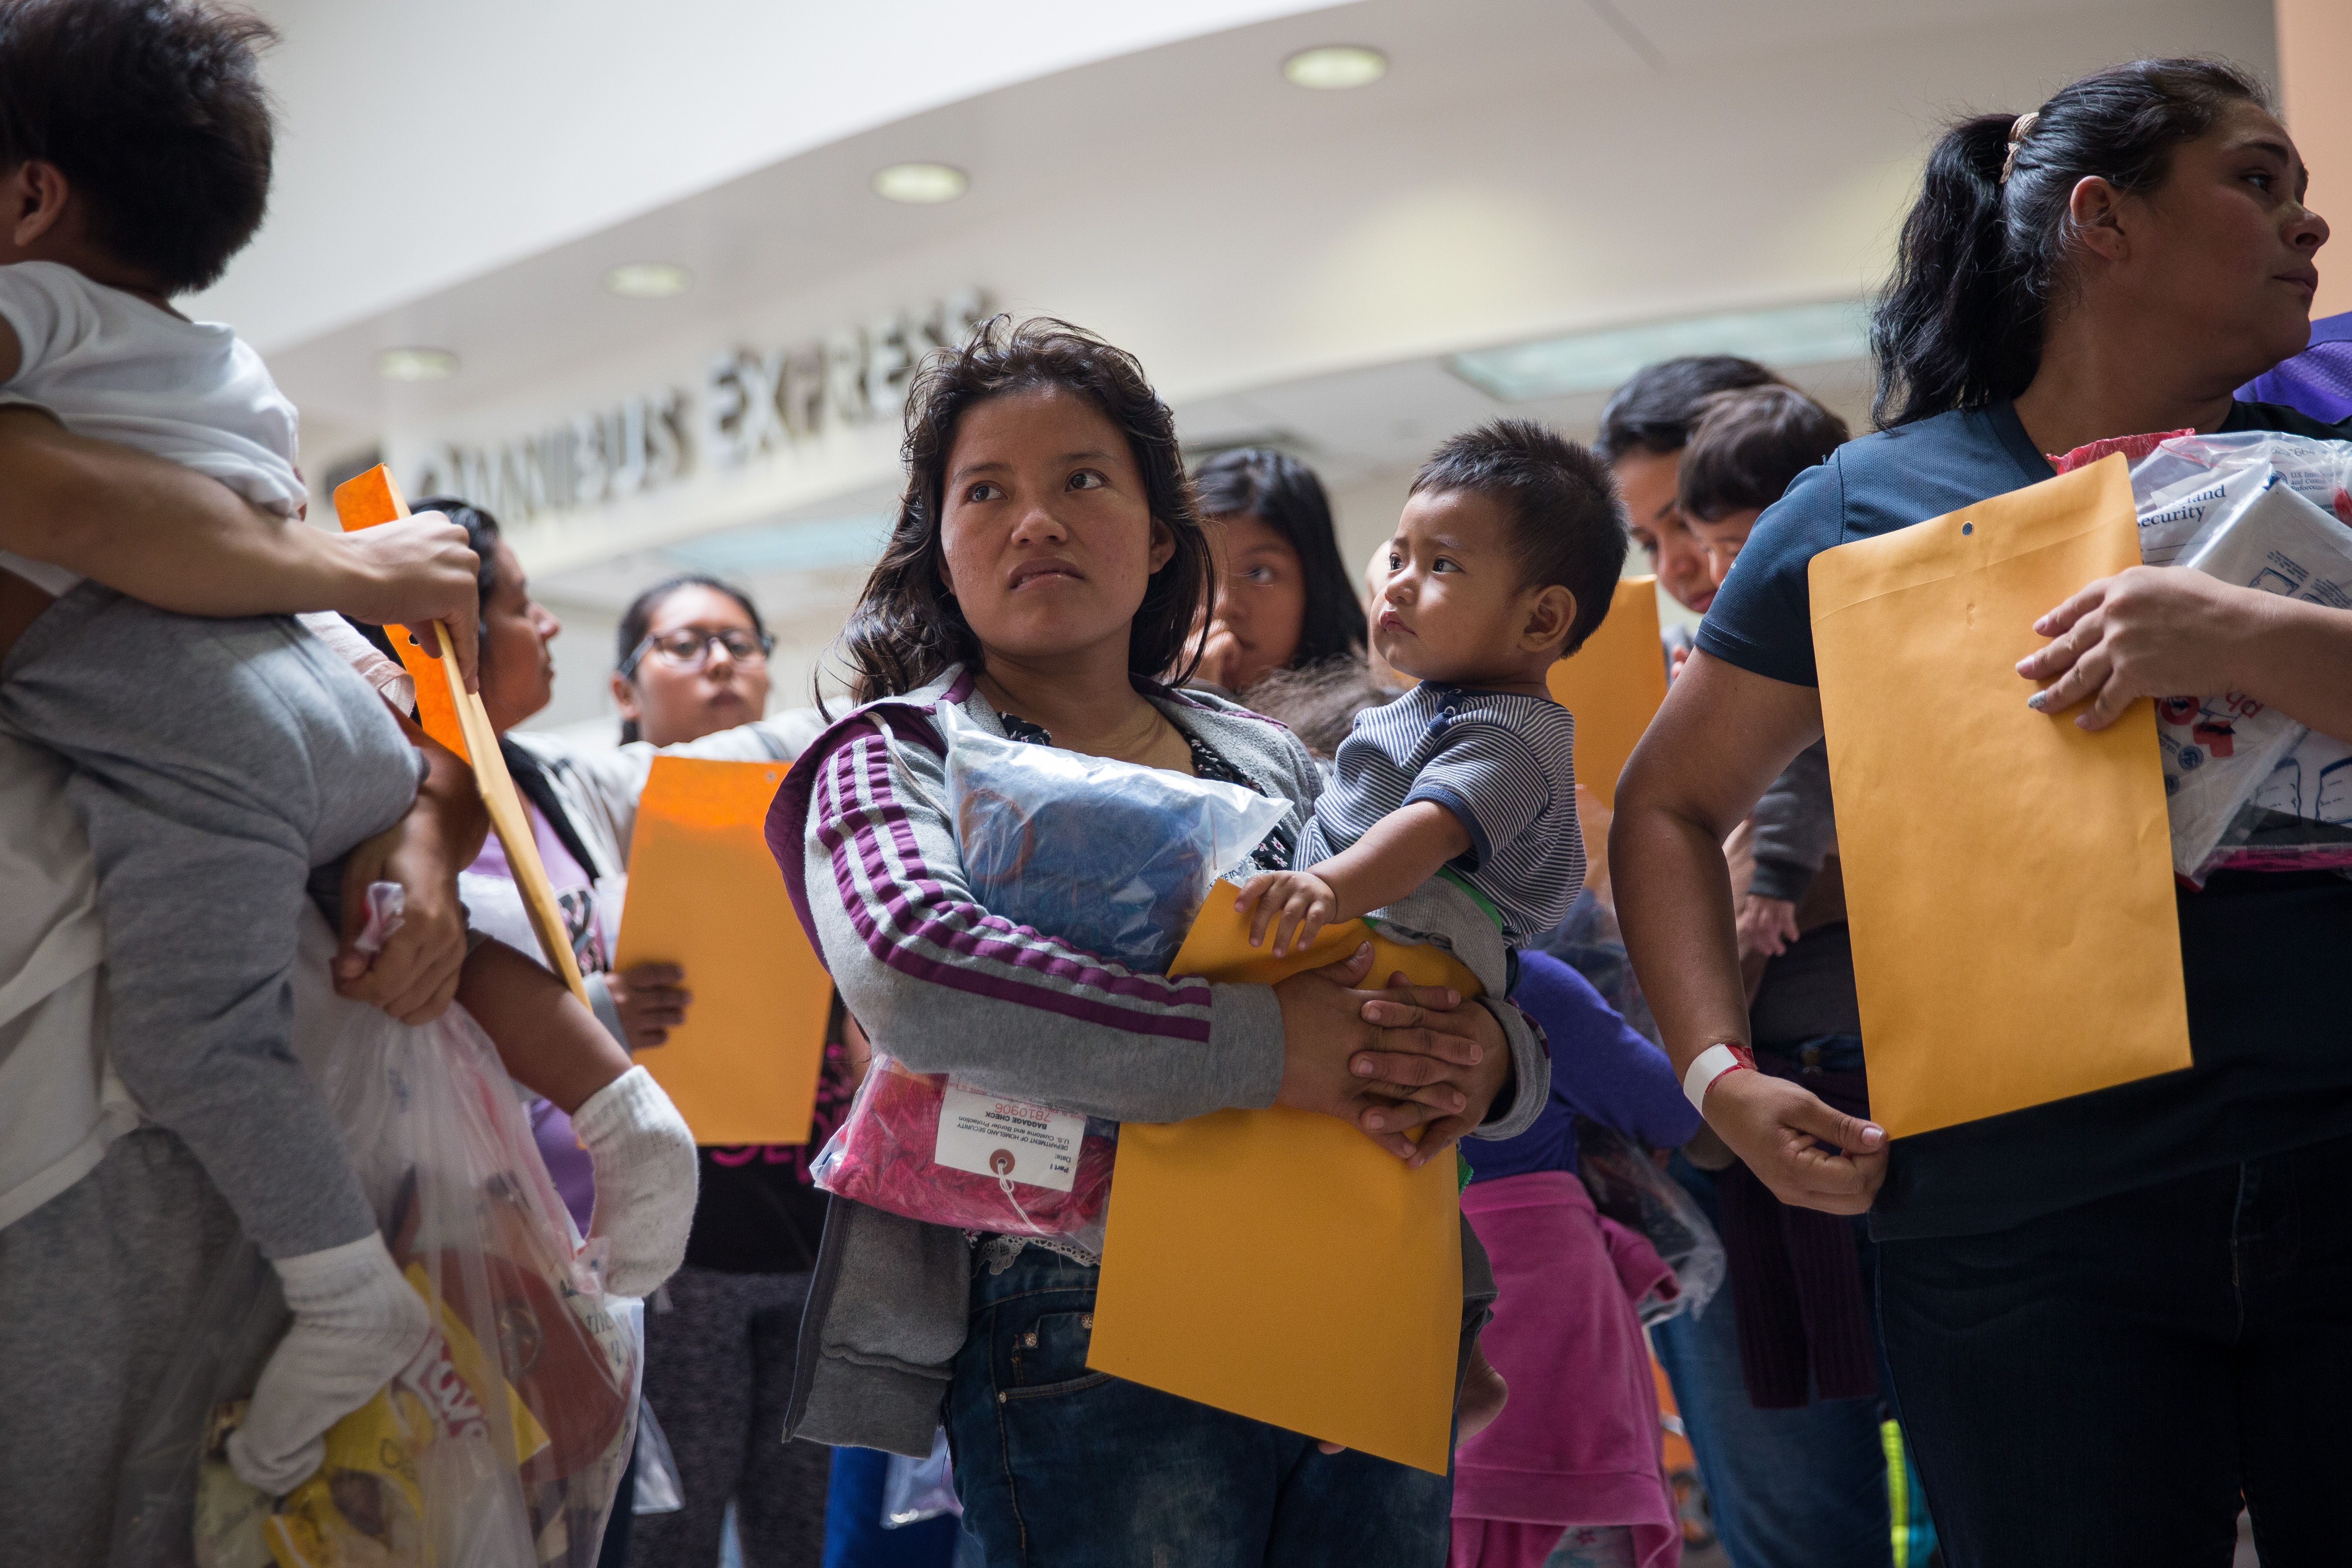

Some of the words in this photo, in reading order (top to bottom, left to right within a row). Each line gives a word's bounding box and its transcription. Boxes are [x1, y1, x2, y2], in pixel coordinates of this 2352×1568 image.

[2138, 505, 2206, 527] ecurity
[985, 1111, 1010, 1121] CHECK
[995, 1103, 1051, 1123] 7810906
[959, 1116, 990, 1127] Protection
[1011, 1117, 1047, 1130] BAGGAGE
[957, 1123, 986, 1133] SECURITY
[991, 1123, 1012, 1132] Border
[987, 1129, 1019, 1140] HOMELAND
[1027, 1131, 1054, 1141] Customs
[1030, 1138, 1068, 1151] DEPARTMENT
[1055, 1154, 1071, 1163] Date:
[1054, 1165, 1069, 1173] Part
